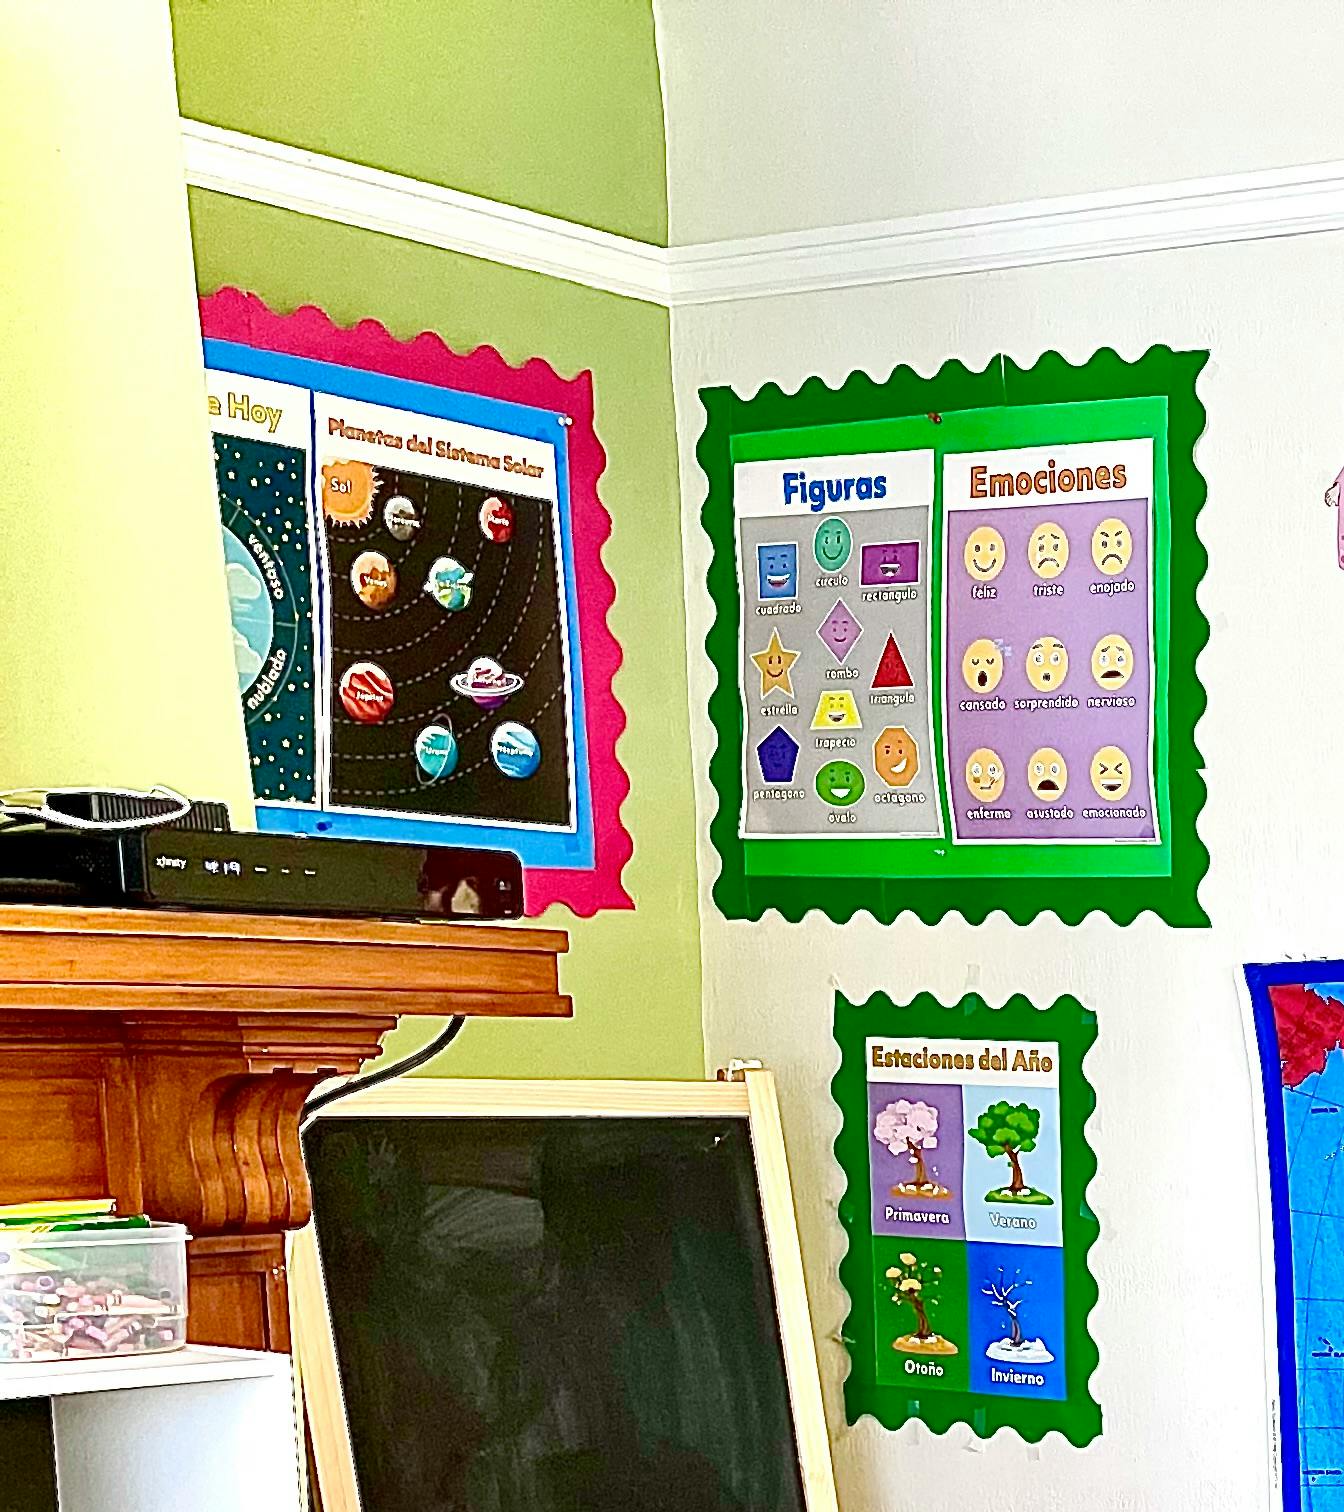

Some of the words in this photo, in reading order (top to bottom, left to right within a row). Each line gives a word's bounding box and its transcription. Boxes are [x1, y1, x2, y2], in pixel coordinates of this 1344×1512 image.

[208, 396, 221, 415] e
[229, 392, 283, 432] Hoy
[328, 417, 403, 449] Planetas
[407, 435, 433, 454] del
[436, 441, 500, 469] Sistema
[503, 455, 544, 478] Solar
[331, 478, 351, 493] Sol
[970, 460, 1127, 498] Emociones
[783, 471, 887, 512] Figuras
[248, 534, 284, 600] ventoso
[971, 583, 996, 599] feliz
[1032, 583, 1065, 597] triste
[1089, 579, 1135, 597] enojado
[755, 602, 801, 616] cuadrado
[247, 649, 287, 710] nublado
[826, 667, 859, 679] rombo
[959, 697, 1006, 712] cansado
[1014, 696, 1079, 710] sorprendido
[1087, 694, 1136, 709] nervioso
[761, 704, 798, 716] estrella
[815, 738, 856, 750] trapecio
[966, 807, 1011, 820] enfermo
[1026, 806, 1074, 820] asustado
[1082, 805, 1147, 820] emocionado
[871, 1045, 973, 1070] Estaciones
[978, 1047, 1008, 1071] del
[1012, 1049, 1054, 1073] Año
[884, 1205, 950, 1225] Primavera
[989, 1212, 1037, 1230] Verano
[904, 1359, 945, 1378] Otoño
[991, 1366, 1045, 1387] Invierno
